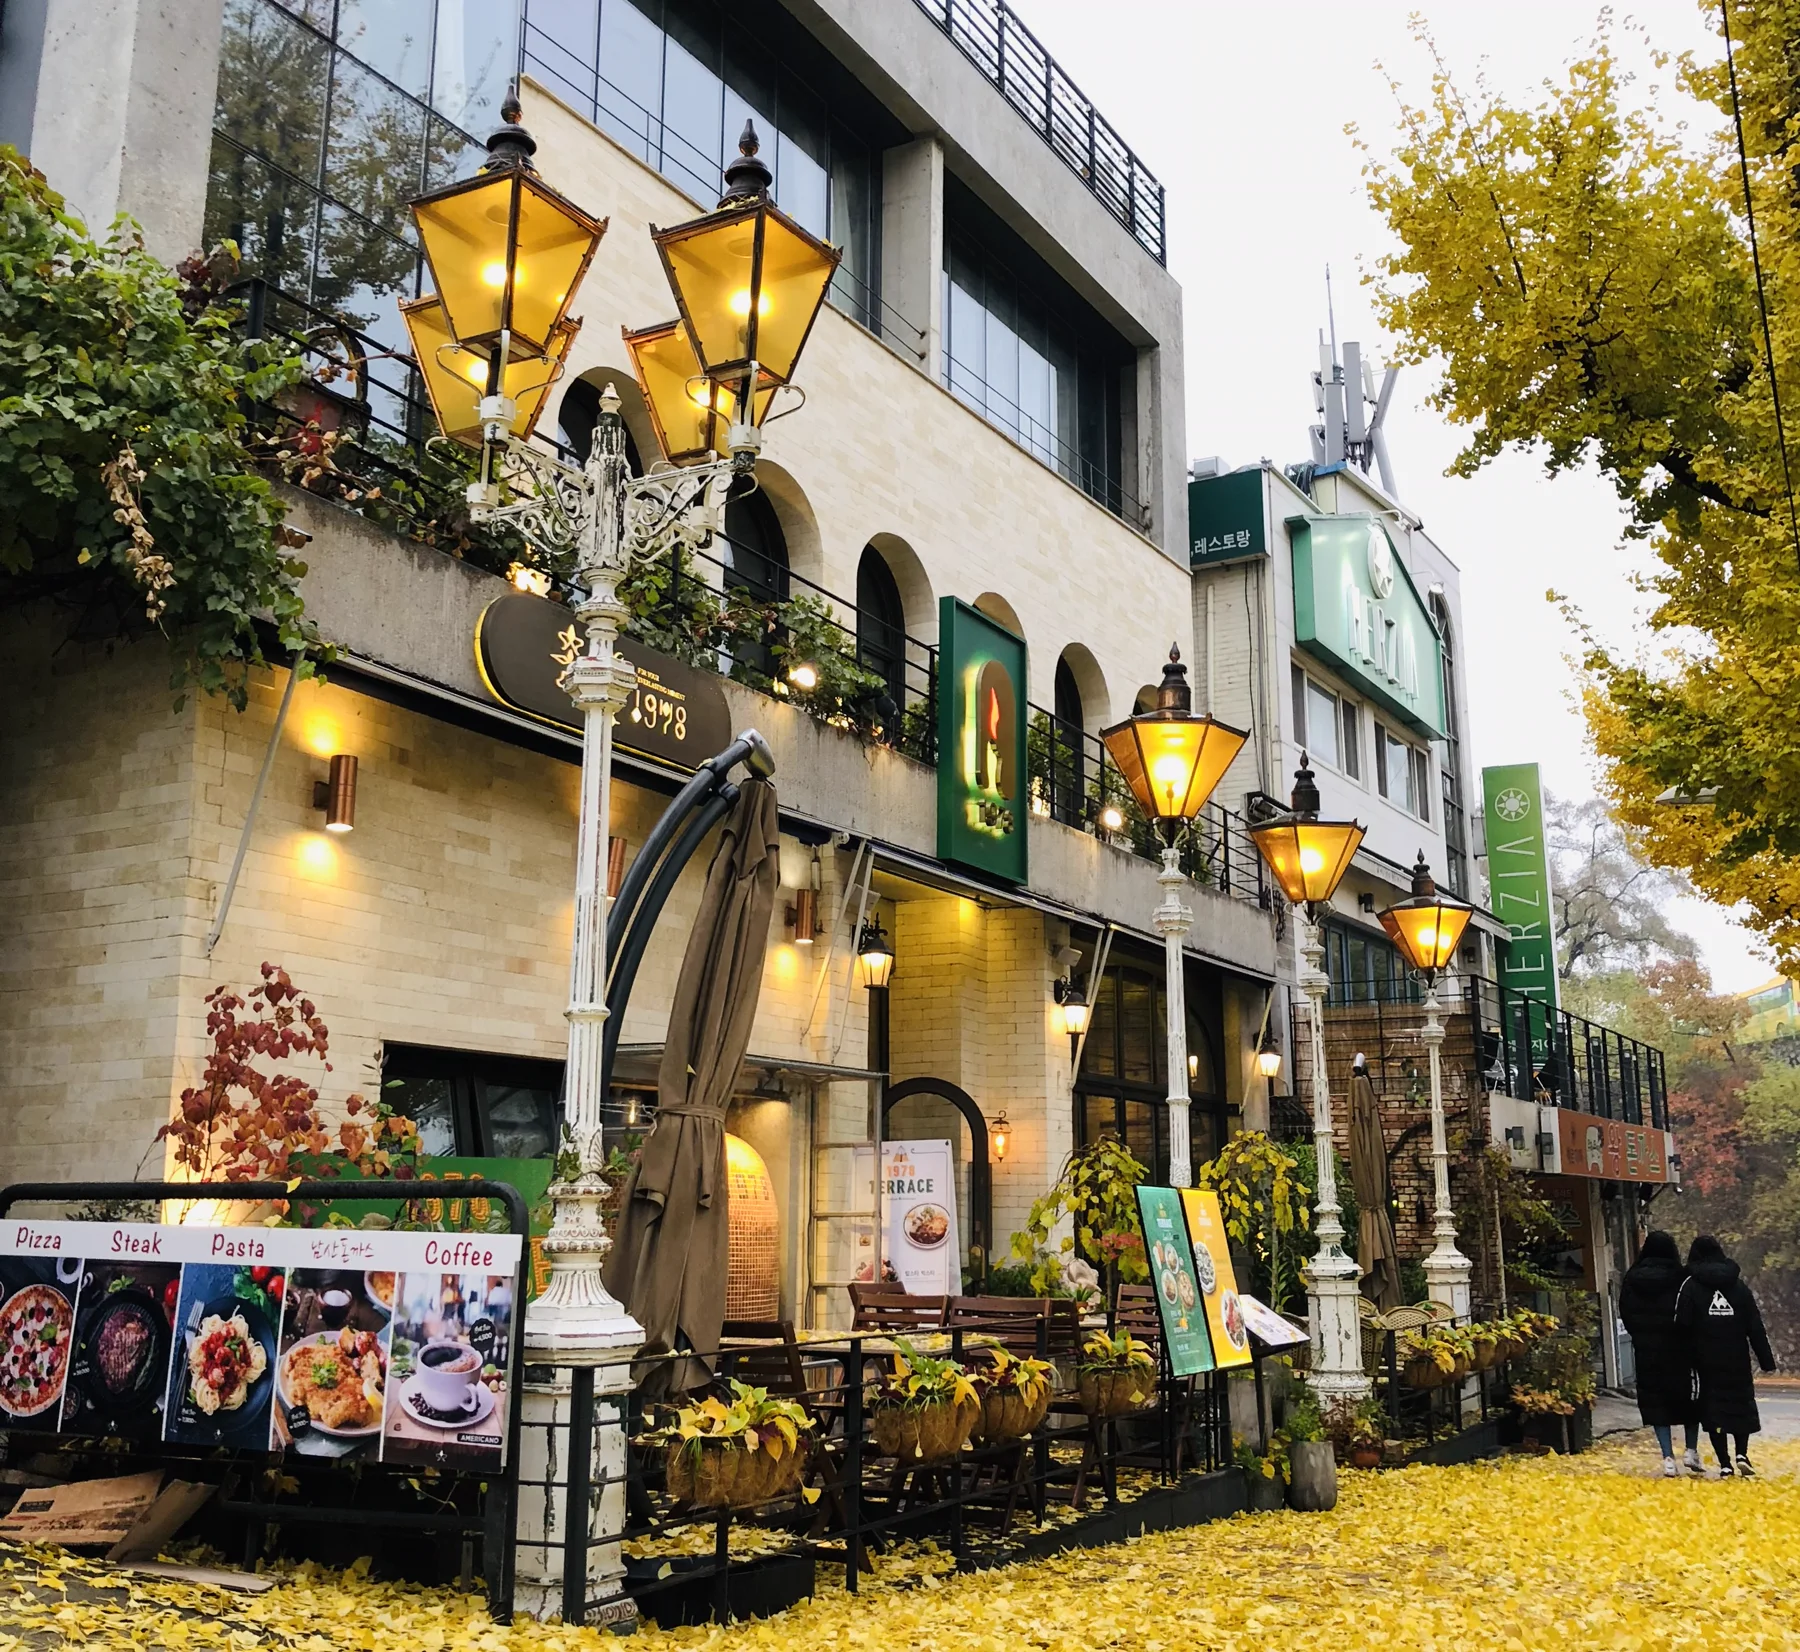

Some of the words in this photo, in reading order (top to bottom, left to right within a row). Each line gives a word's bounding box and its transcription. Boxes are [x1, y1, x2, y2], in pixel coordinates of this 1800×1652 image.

[631, 689, 687, 741] 1978
[1496, 835, 1548, 1005] HERZIA
[15, 1226, 62, 1250] Pizza
[111, 1230, 162, 1255] Steak
[211, 1233, 265, 1259] Pasta
[311, 1237, 375, 1263] 남산돈까스
[425, 1240, 493, 1266] Coffee
[460, 1434, 500, 1444] AMERICANO
